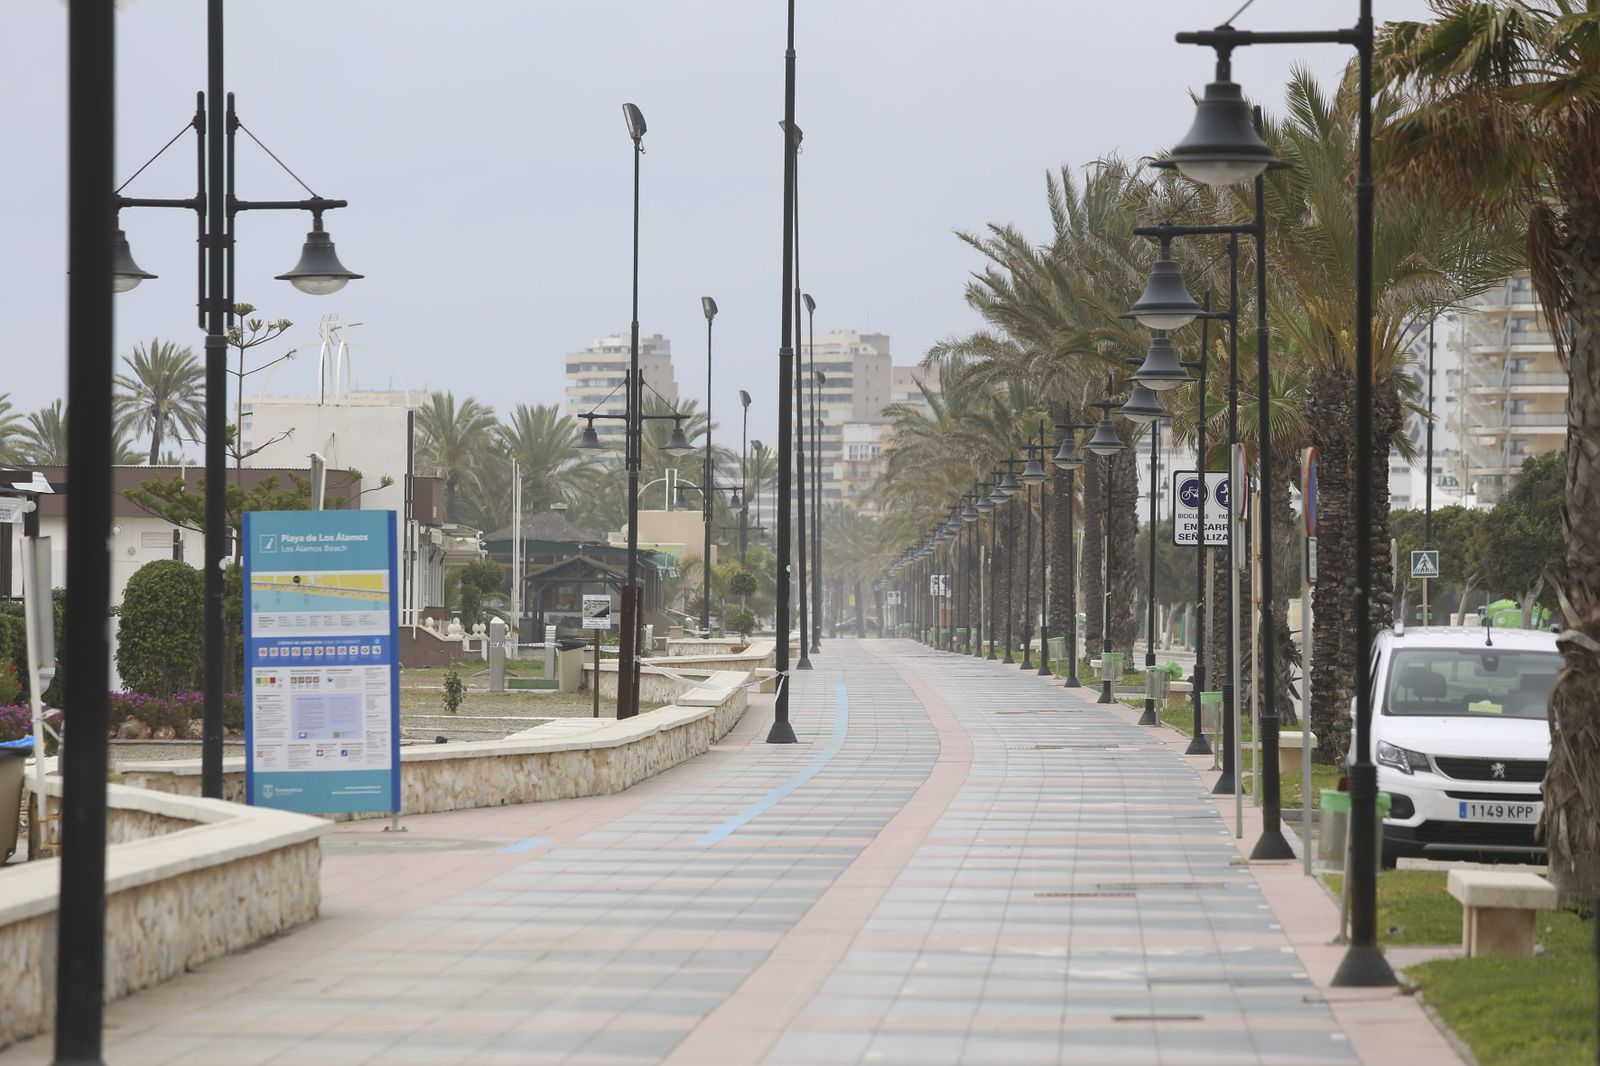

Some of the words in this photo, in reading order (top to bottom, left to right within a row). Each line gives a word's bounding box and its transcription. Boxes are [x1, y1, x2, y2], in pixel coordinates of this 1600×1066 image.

[1184, 523, 1198, 531] EN
[1204, 523, 1228, 531] CARR
[281, 534, 303, 543] Playa
[306, 534, 318, 542] de
[319, 533, 334, 542] Los
[336, 531, 369, 541] Álamos
[1178, 532, 1229, 541] SEÑLIZA
[295, 544, 322, 552] Álamos
[324, 544, 348, 552] Beach
[1471, 805, 1504, 818] 1149
[1507, 806, 1533, 819] KPP
